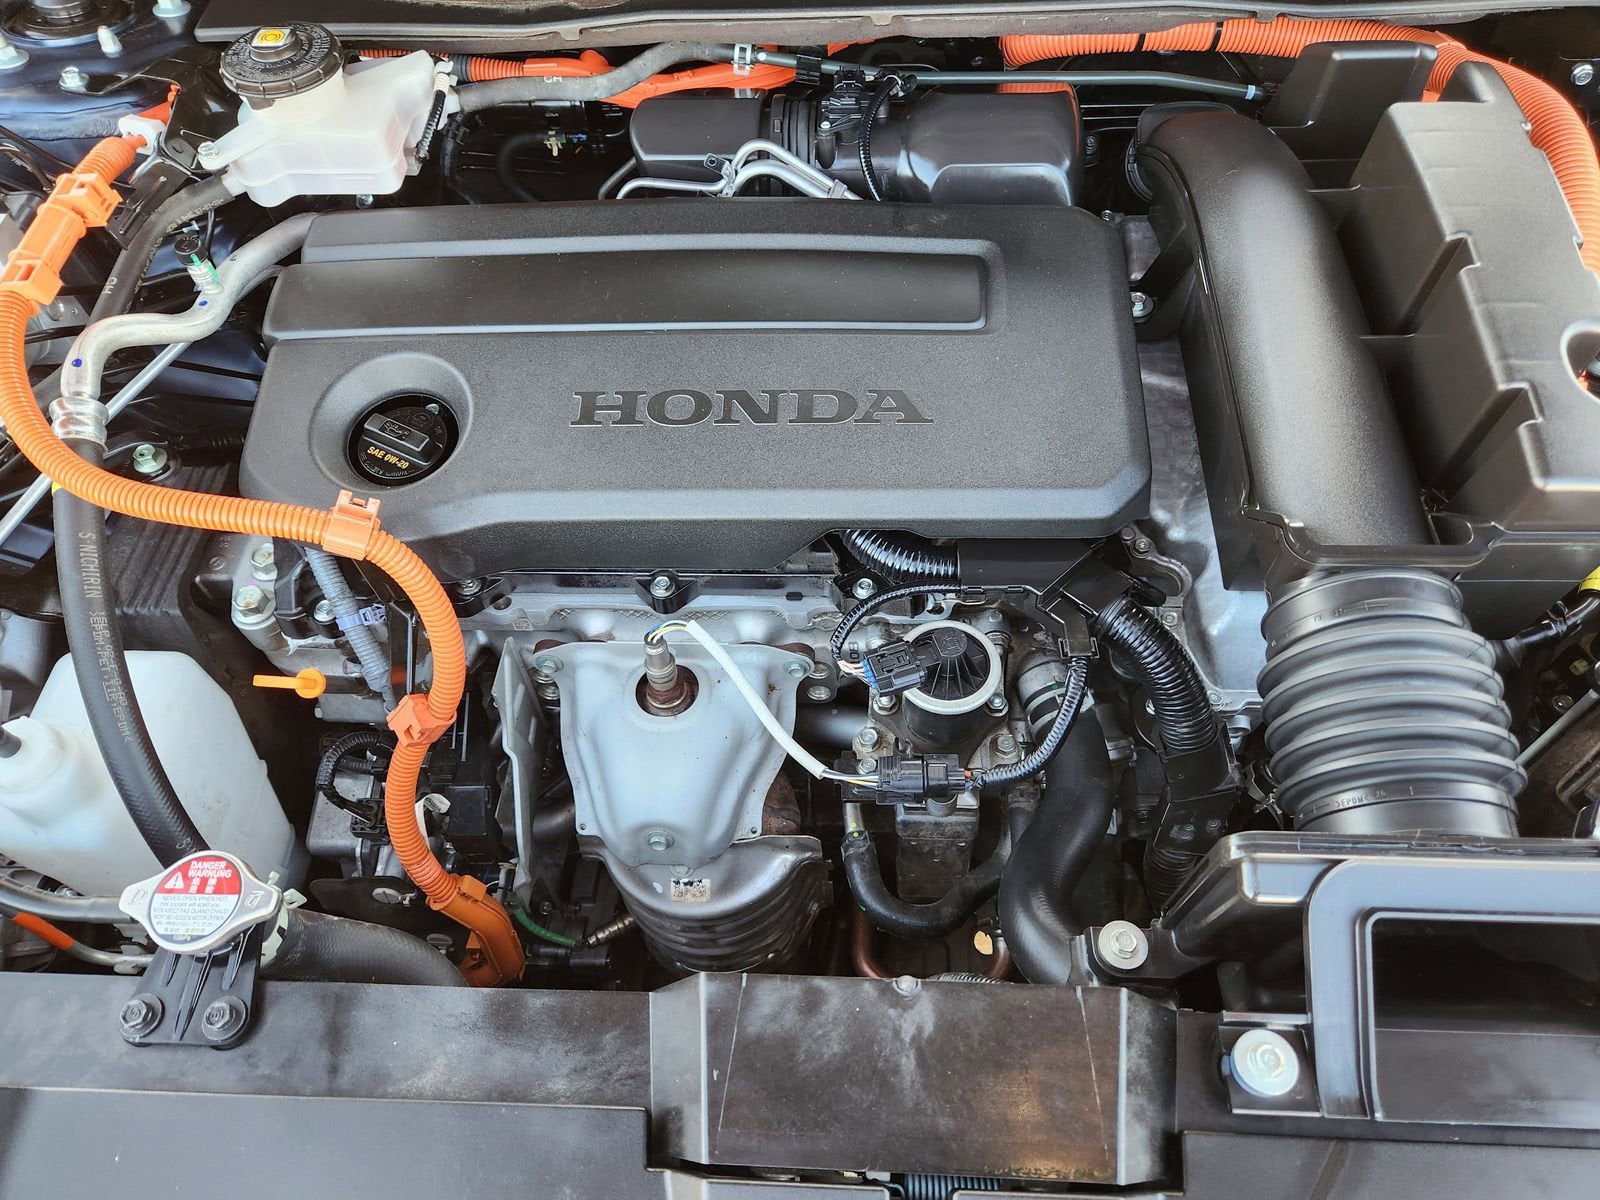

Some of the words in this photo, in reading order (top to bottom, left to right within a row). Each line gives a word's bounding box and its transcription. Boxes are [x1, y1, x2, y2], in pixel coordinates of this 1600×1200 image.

[569, 389, 934, 427] HONDA
[367, 446, 386, 459] SAE
[384, 453, 410, 470] 0W-20
[187, 869, 232, 878] WARNUNG
[190, 861, 227, 870] DANGER
